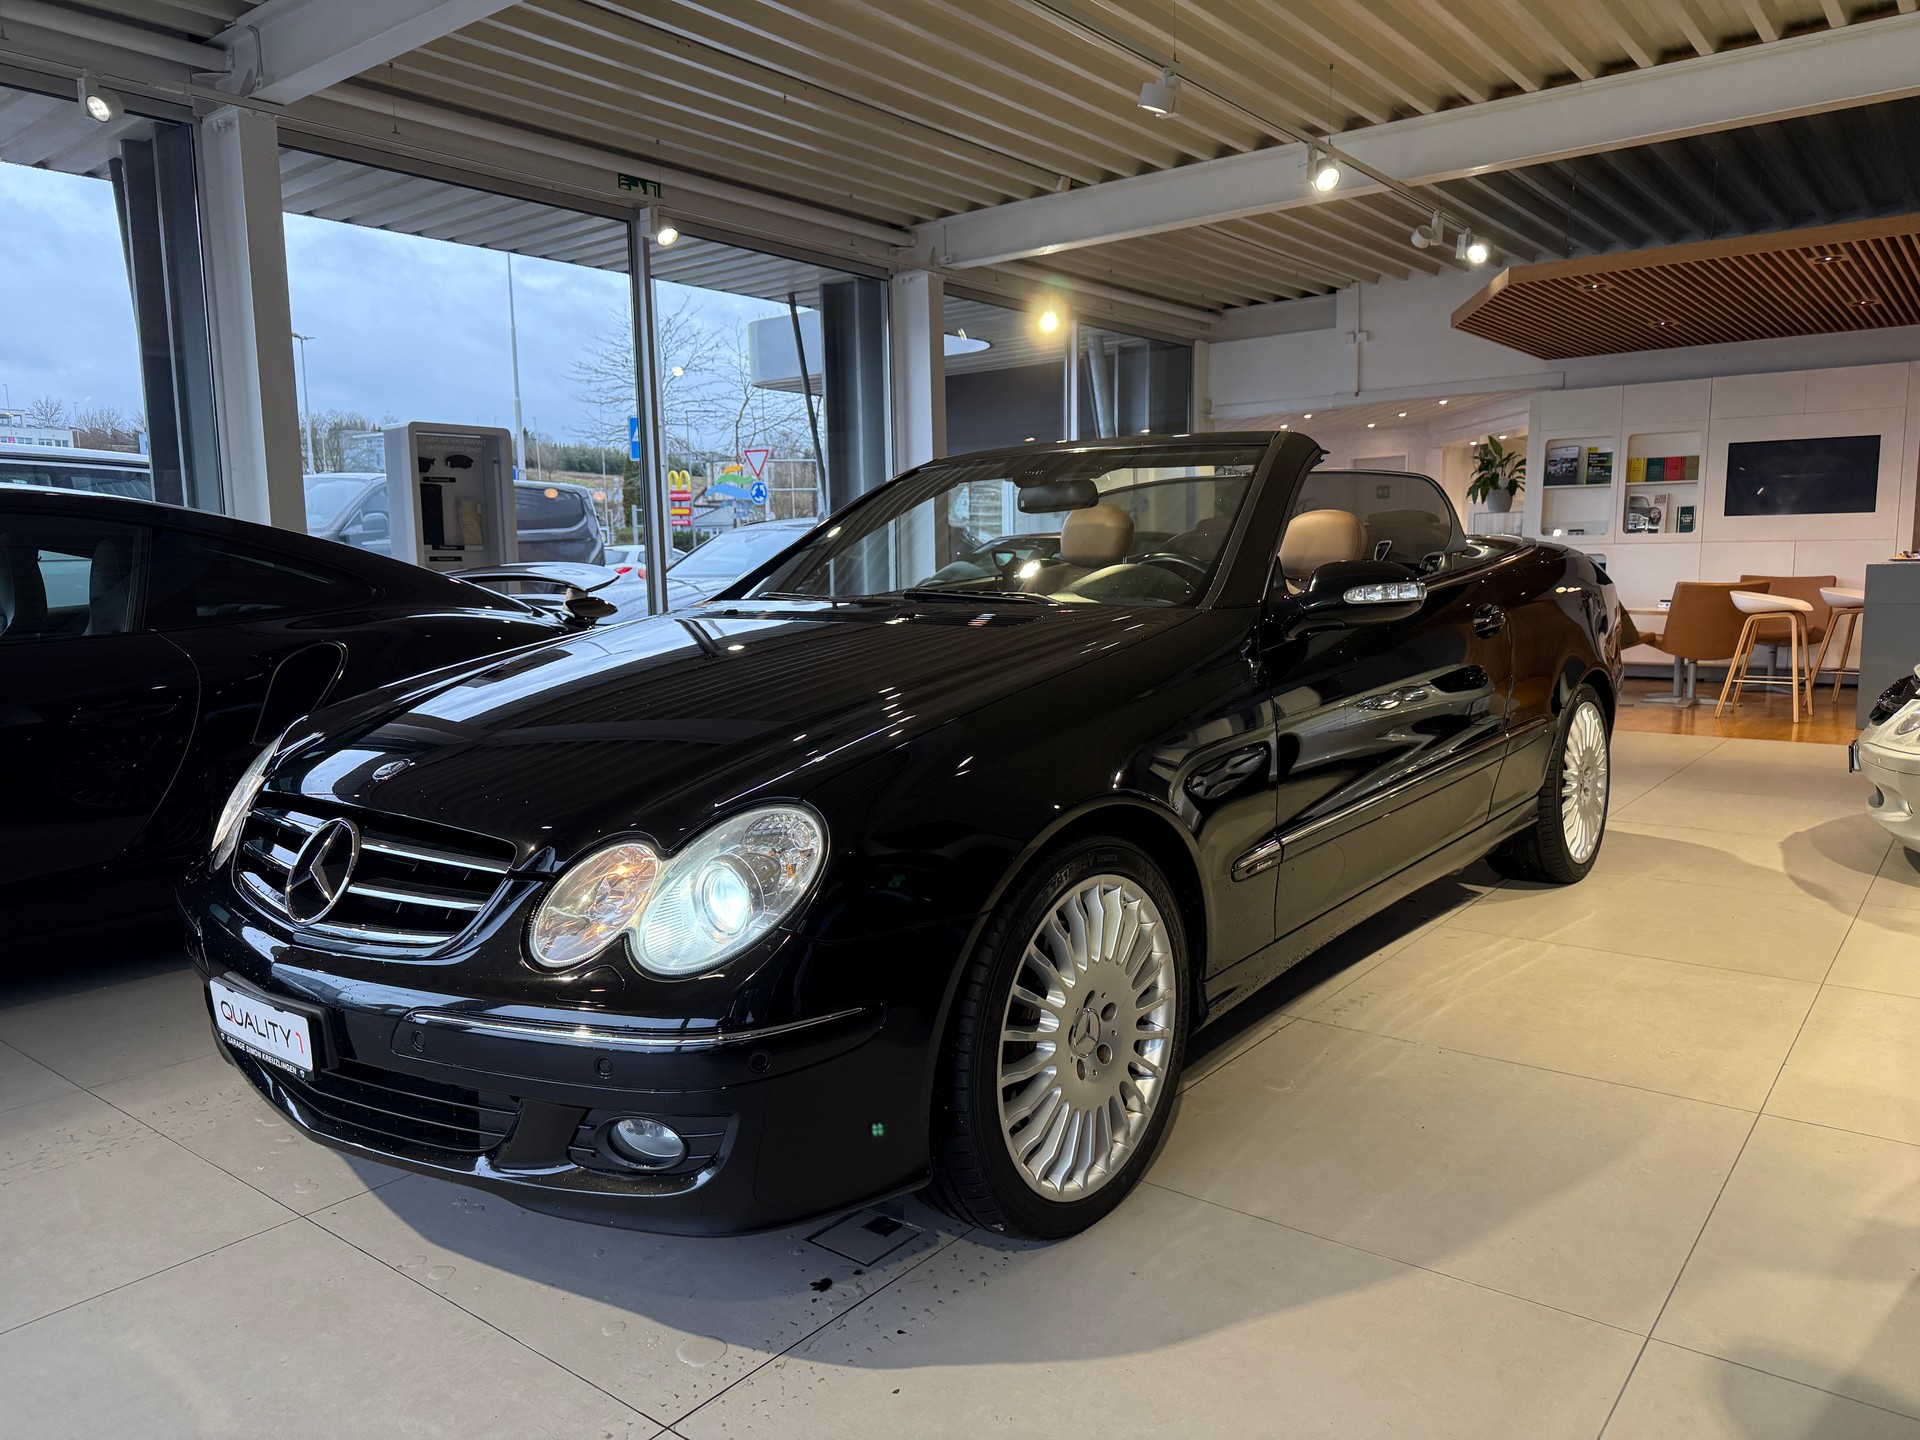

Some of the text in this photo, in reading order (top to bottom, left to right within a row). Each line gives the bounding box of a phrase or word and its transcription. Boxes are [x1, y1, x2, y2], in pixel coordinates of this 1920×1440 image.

[226, 1036, 297, 1075] GARAGE SIMON KREUZLINGEN
